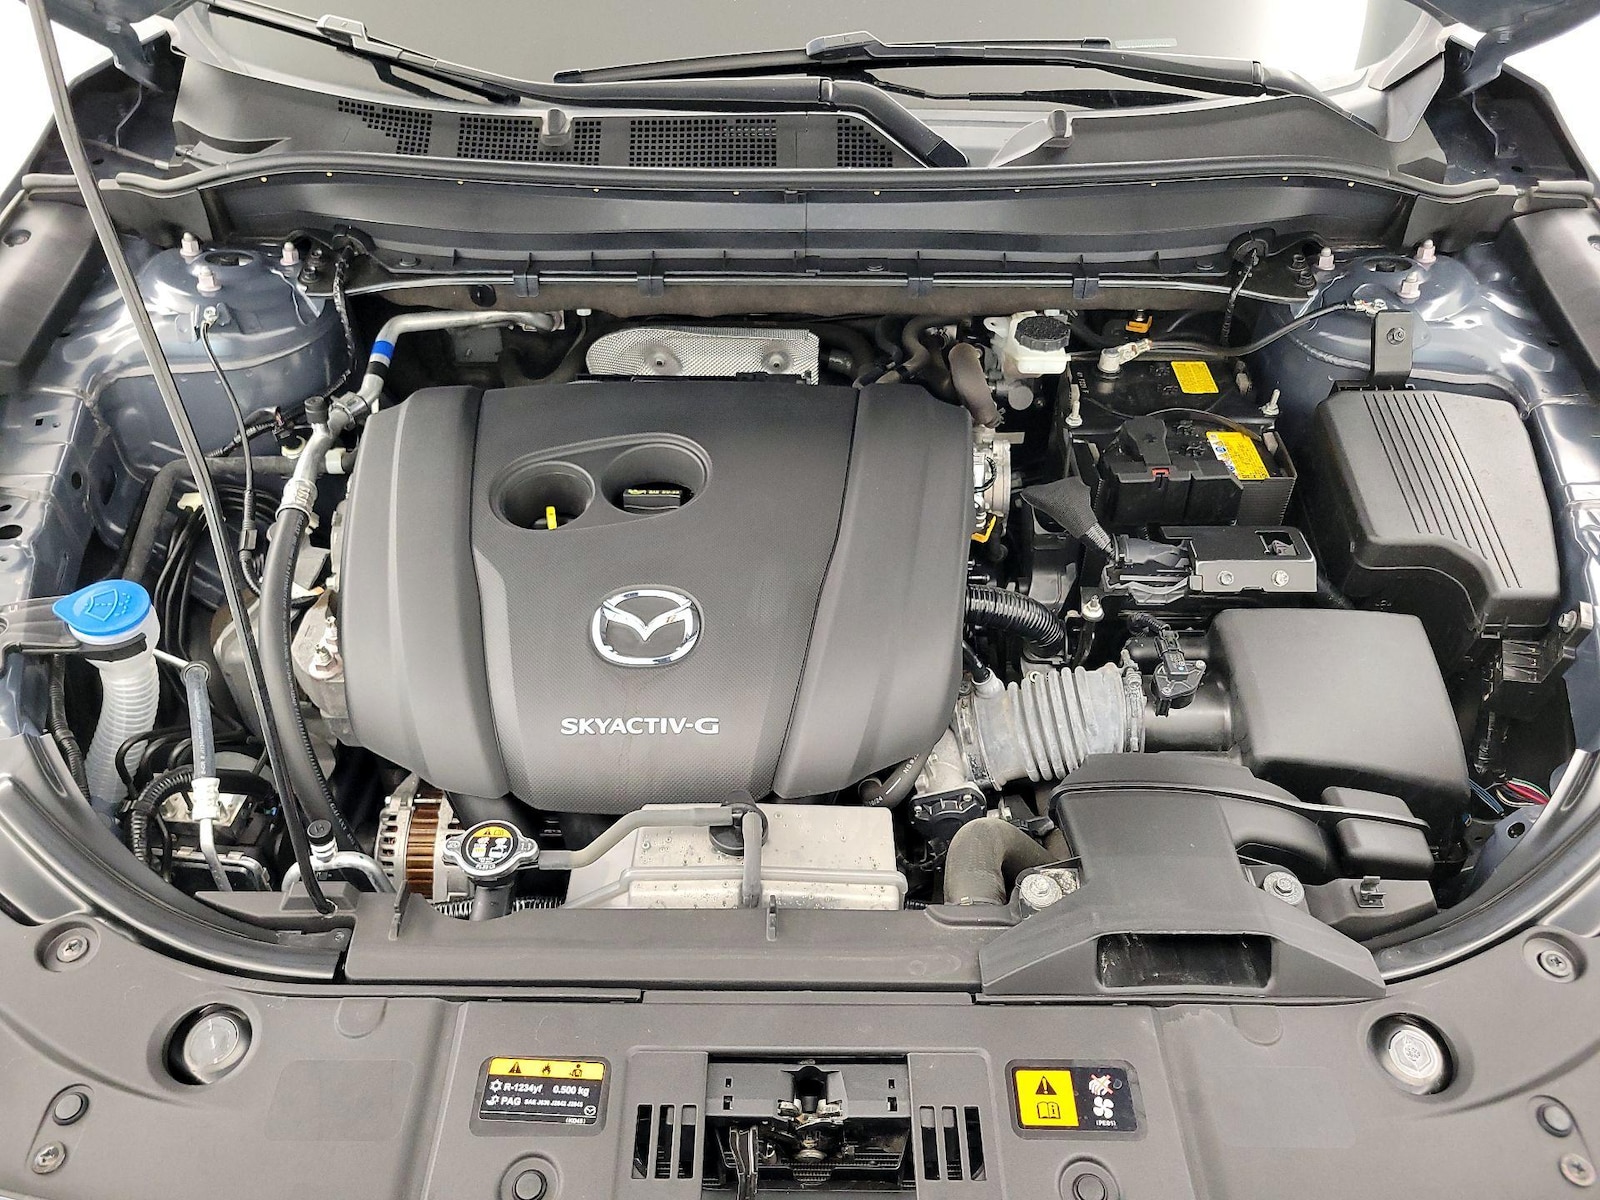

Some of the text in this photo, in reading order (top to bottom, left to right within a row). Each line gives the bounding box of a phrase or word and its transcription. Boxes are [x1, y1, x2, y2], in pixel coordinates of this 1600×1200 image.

[560, 717, 720, 735] SKYACTIV-G
[503, 1082, 590, 1097] R-1234yf 0.500 kg
[500, 1096, 522, 1106] PAG
